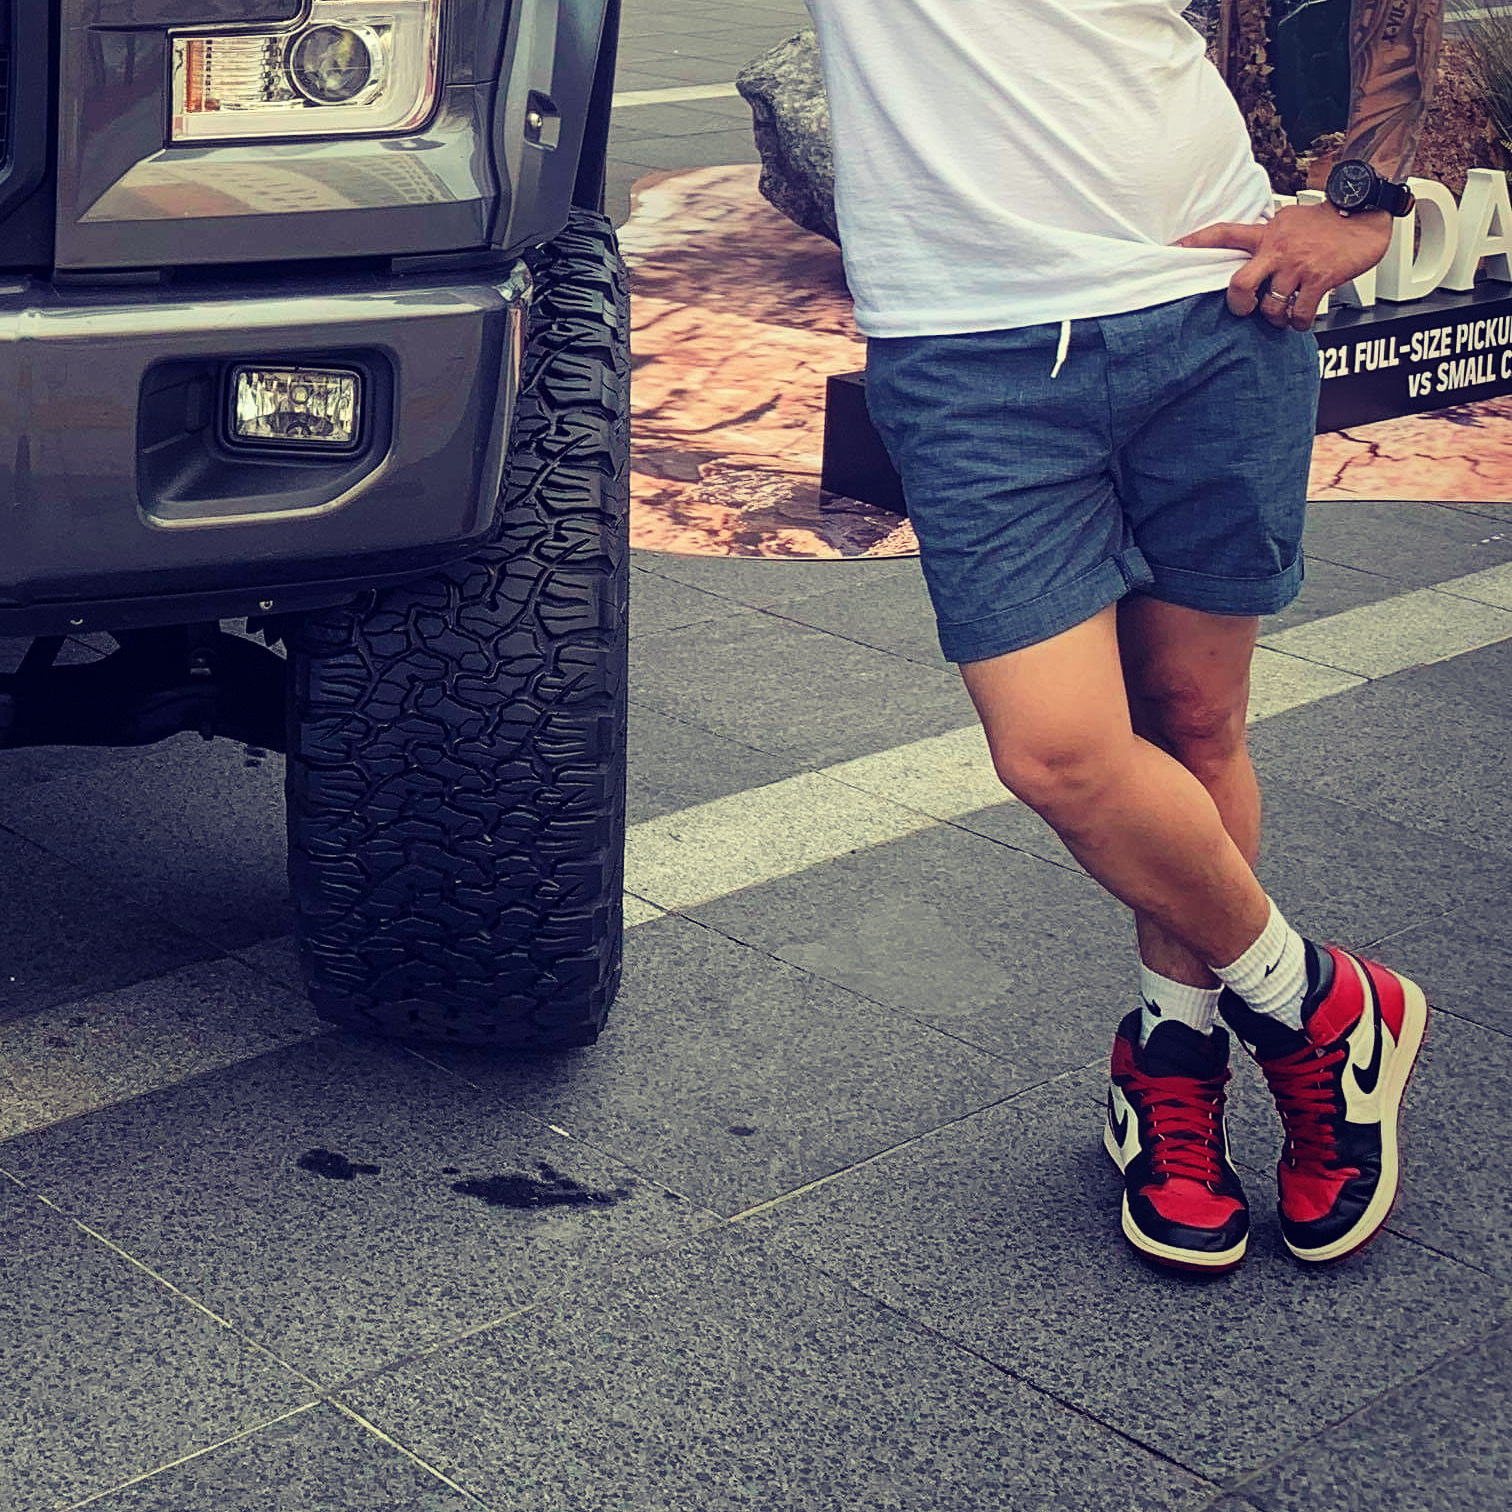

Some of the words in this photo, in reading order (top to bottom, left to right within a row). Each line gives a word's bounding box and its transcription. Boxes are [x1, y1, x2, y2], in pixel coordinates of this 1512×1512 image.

[1353, 326, 1453, 374] FULL-SIZE
[1455, 315, 1512, 354] PICKU
[1435, 353, 1496, 392] SMALL
